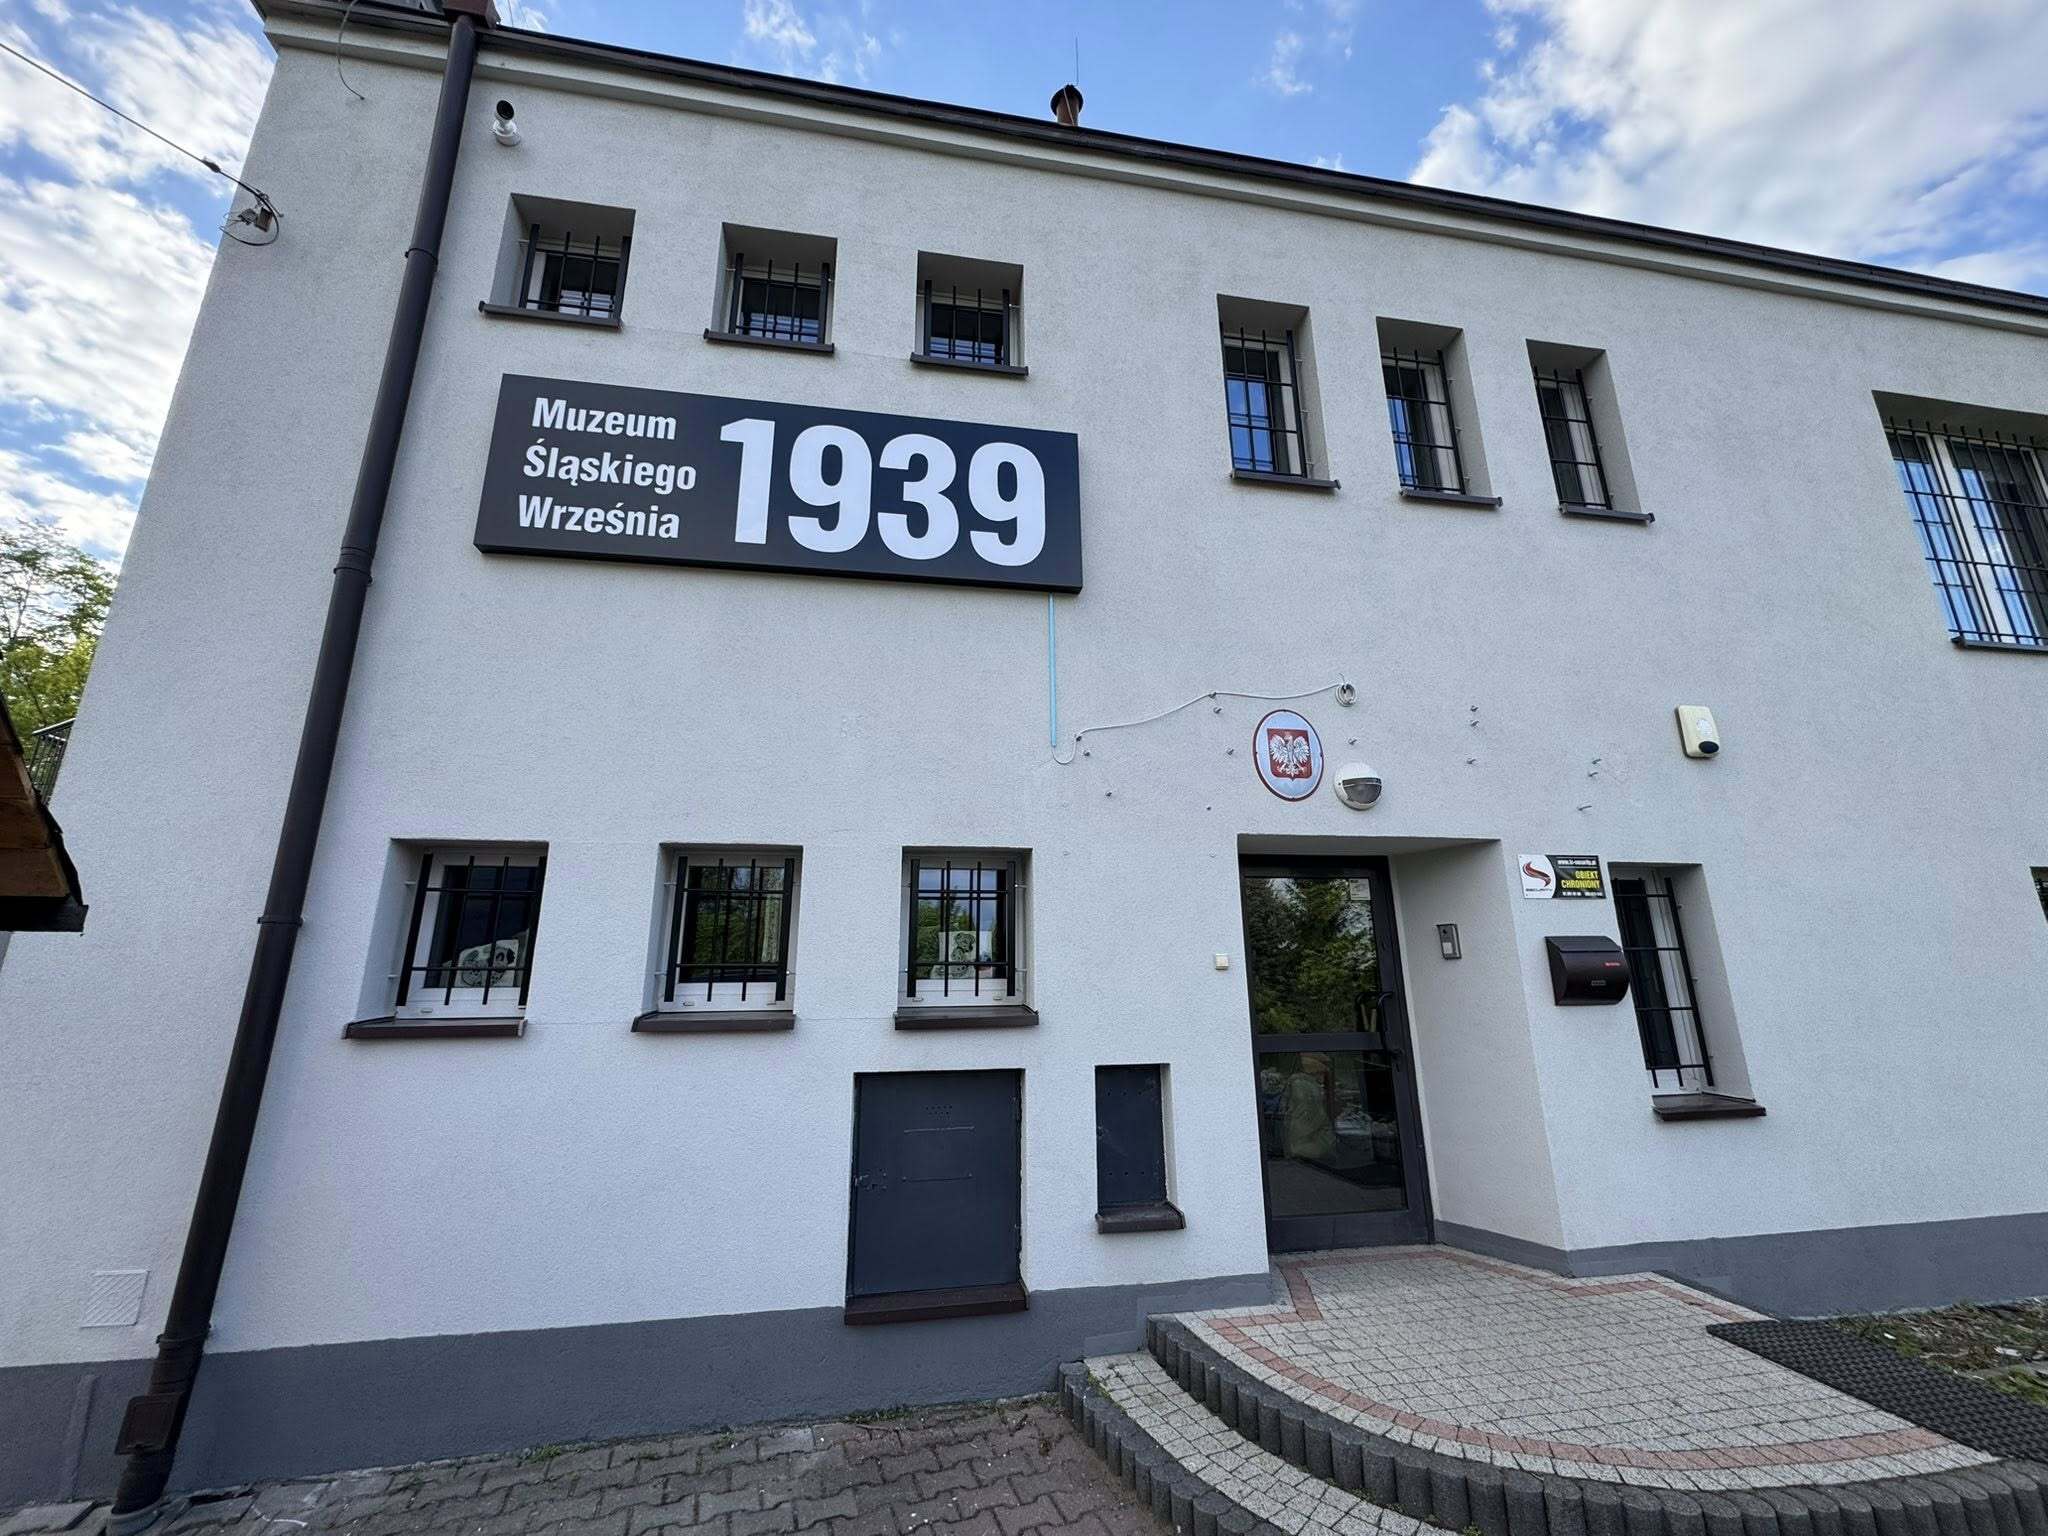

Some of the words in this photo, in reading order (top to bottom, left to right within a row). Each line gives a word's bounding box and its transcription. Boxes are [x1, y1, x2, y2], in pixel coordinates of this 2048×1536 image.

[531, 397, 677, 440] Muzeum
[523, 438, 697, 495] Śląskiego
[719, 417, 1046, 567] 1939
[517, 494, 680, 539] Września
[1561, 879, 1601, 889] CHRONIONY
[1575, 870, 1599, 879] OBIEKT
